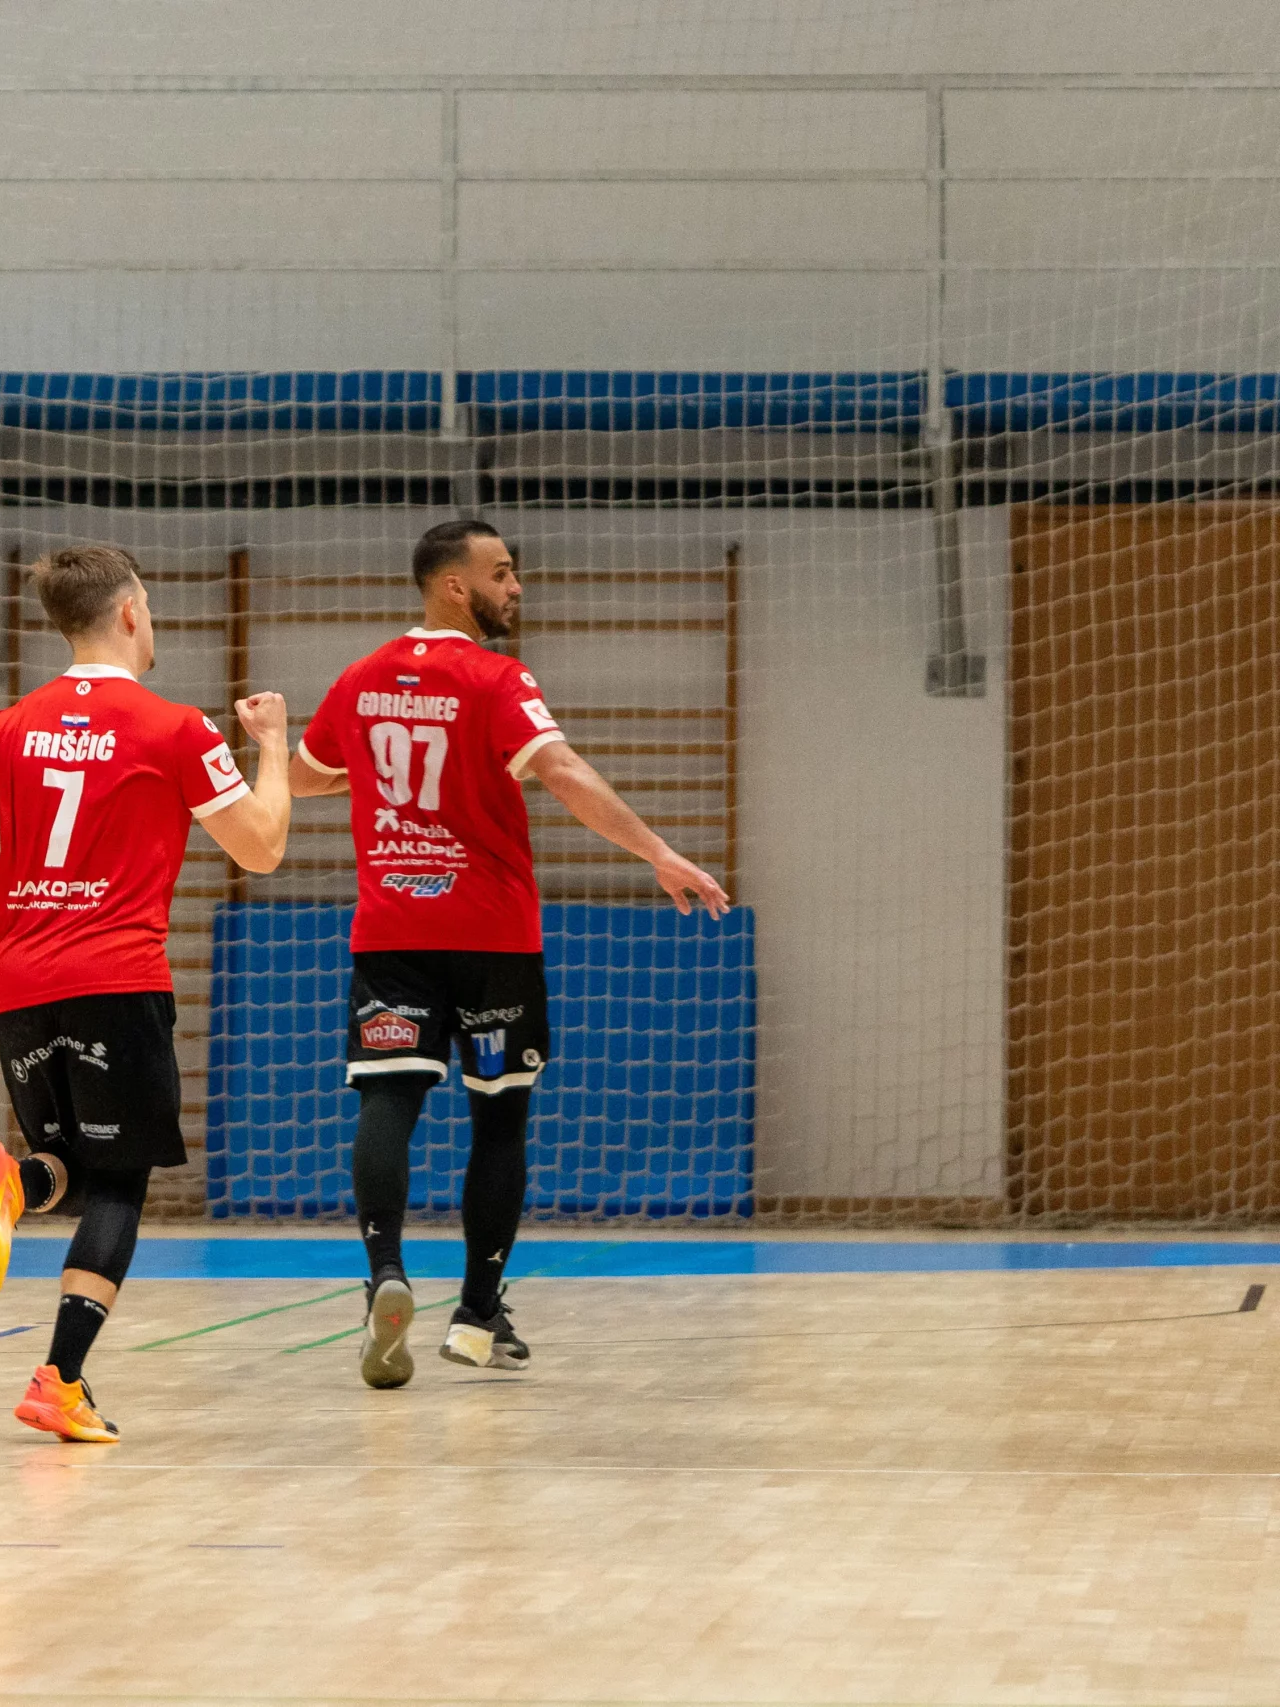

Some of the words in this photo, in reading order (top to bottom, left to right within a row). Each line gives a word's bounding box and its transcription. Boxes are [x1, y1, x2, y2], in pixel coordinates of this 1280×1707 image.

[22, 729, 117, 762] FRIŠČIĆ
[369, 721, 448, 811] 97
[42, 767, 85, 868] 7
[367, 840, 468, 859] JAKOPIĆ
[8, 878, 110, 898] JAKOPIĆ
[364, 1025, 414, 1043] VAJDA
